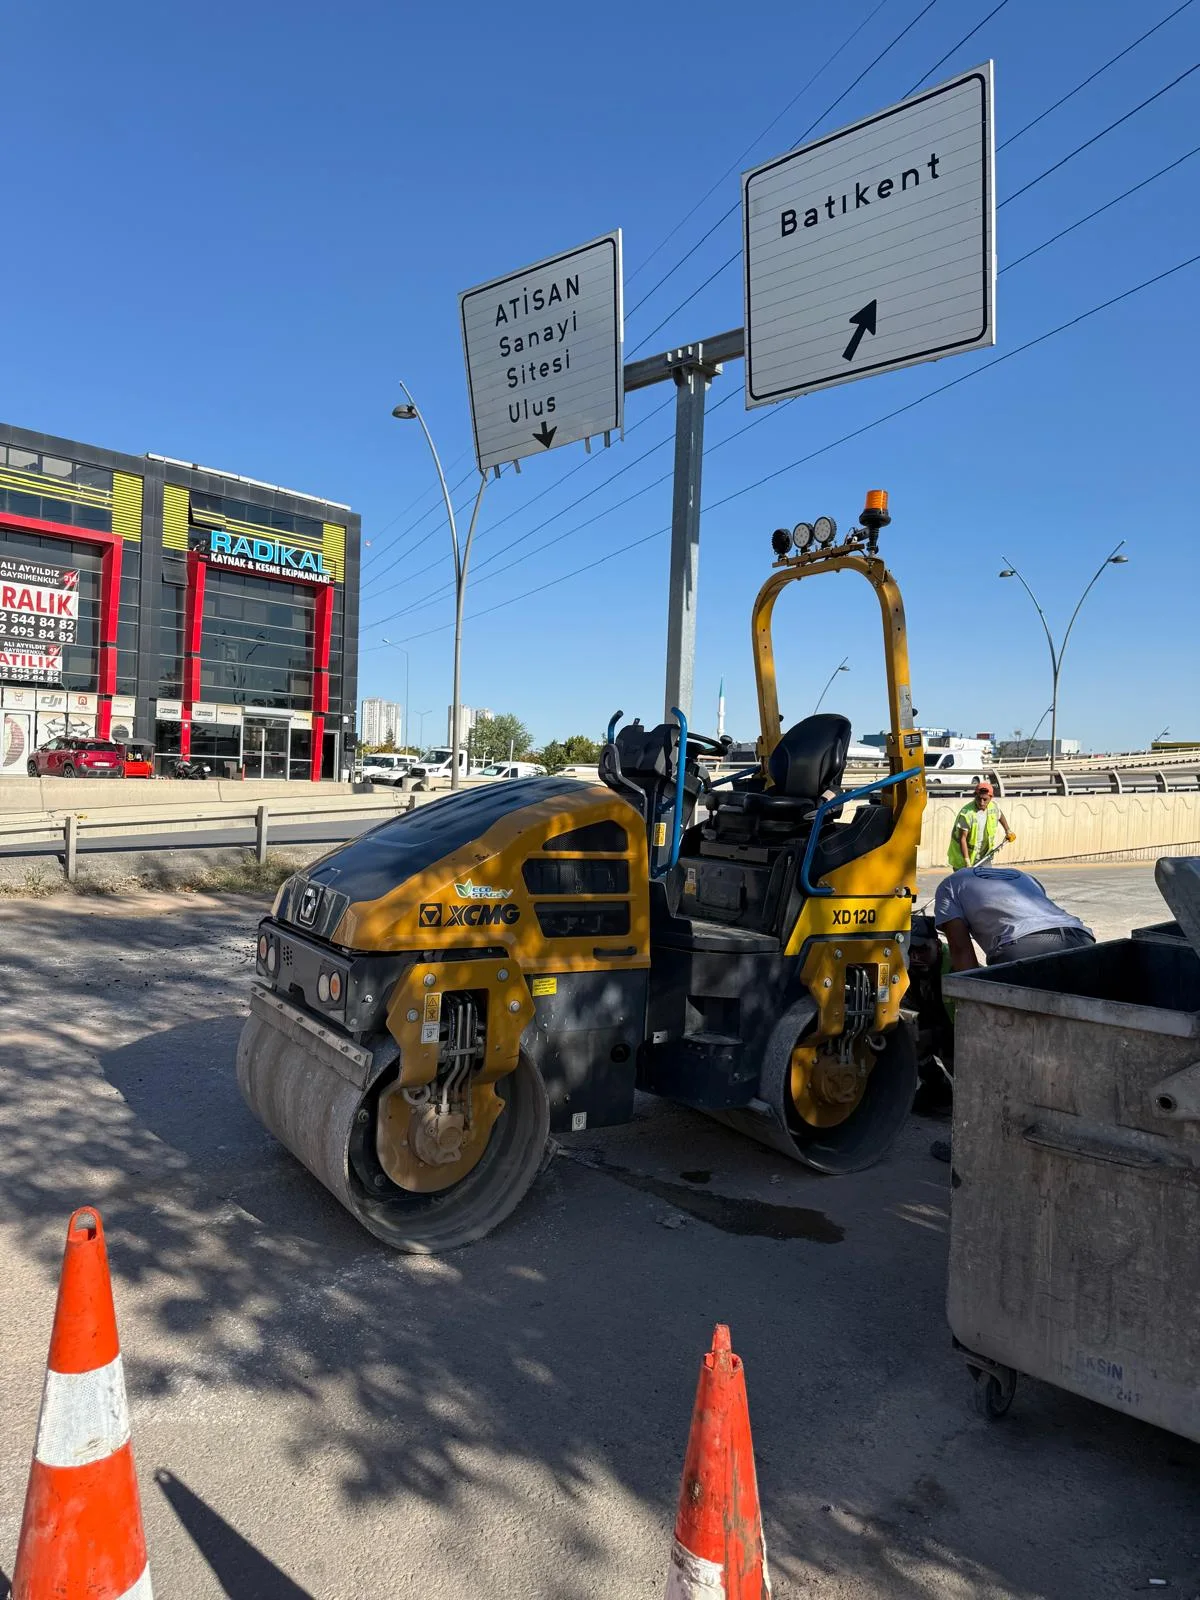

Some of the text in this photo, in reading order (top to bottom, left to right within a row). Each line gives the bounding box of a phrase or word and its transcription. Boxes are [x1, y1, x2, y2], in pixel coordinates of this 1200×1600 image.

[780, 153, 940, 237] Batıkent
[495, 274, 580, 327] ATİSAN
[499, 311, 577, 357] Sanayi
[506, 349, 570, 388] Sitesi
[508, 395, 556, 423] Ulus
[210, 530, 331, 574] RADİKAL
[210, 553, 246, 568] KAYNAK
[247, 560, 254, 569] &
[255, 562, 281, 575] KESME
[18, 564, 60, 577] AYYILDIZ
[2, 585, 73, 617] RALIK
[10, 625, 35, 637] 495
[38, 629, 55, 640] 84
[58, 631, 74, 642] 82
[11, 613, 36, 625] 544
[39, 617, 56, 628] 84
[59, 620, 74, 630] 82
[16, 642, 47, 650] AYYILDIZ
[443, 903, 520, 927] XCMG
